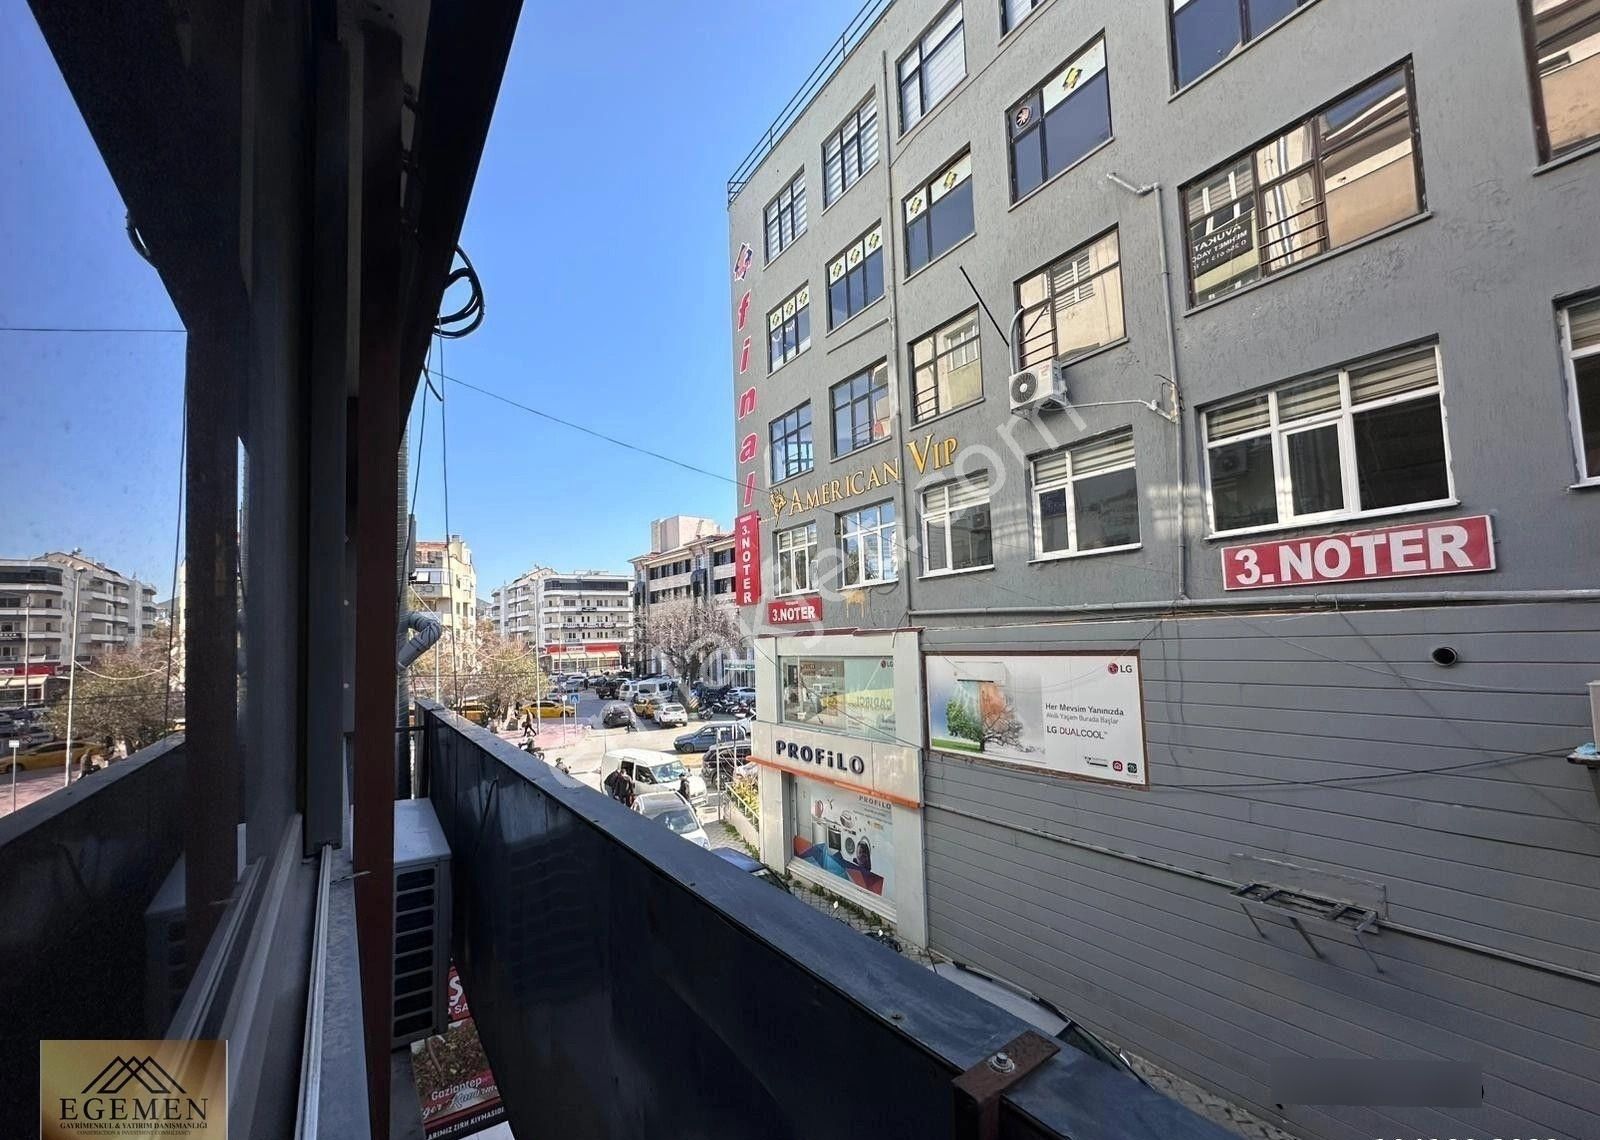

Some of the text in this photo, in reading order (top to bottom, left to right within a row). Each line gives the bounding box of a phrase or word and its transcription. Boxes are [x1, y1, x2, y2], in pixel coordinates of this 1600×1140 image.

[737, 288, 758, 507] final
[789, 432, 958, 517] AMERICAN VIP
[1234, 525, 1473, 585] 3.NOTER
[772, 605, 815, 622] 3.NOTER
[1120, 664, 1132, 673] LG
[1060, 704, 1086, 713] Mevsim
[1046, 725, 1057, 734] LG
[431, 1077, 482, 1101] Gaziantep
